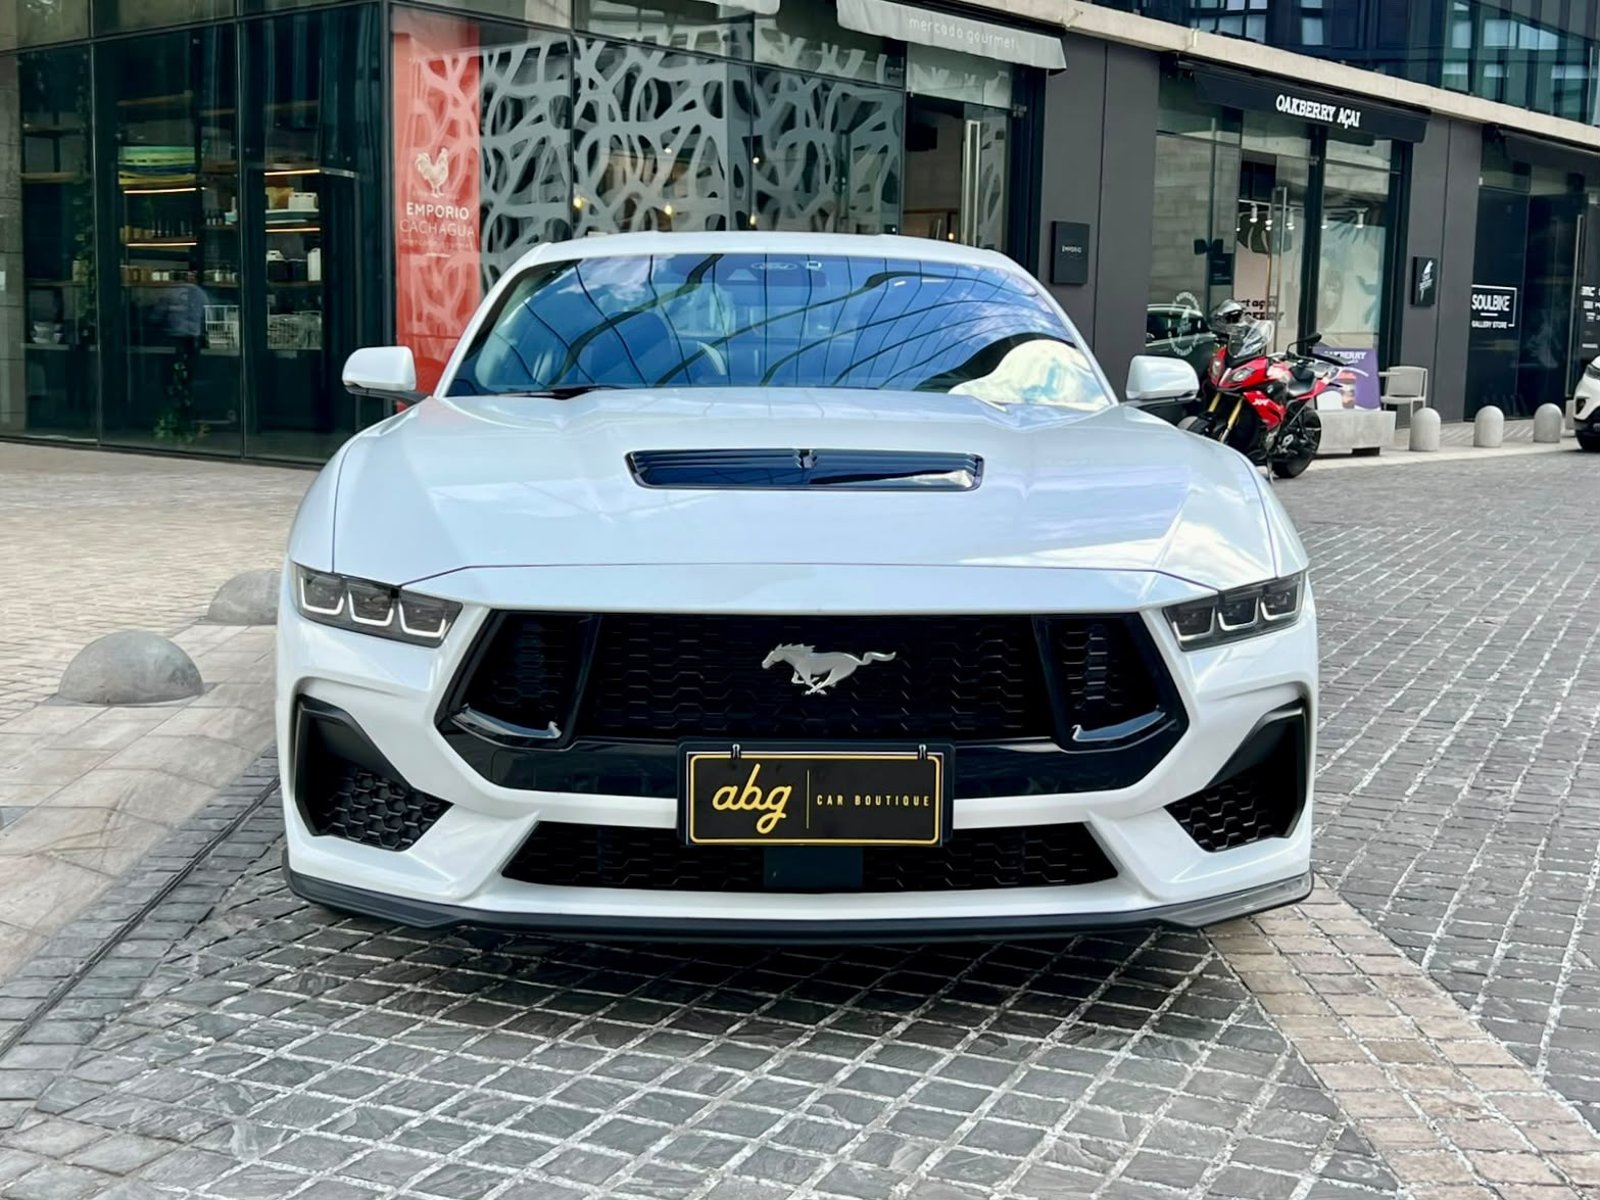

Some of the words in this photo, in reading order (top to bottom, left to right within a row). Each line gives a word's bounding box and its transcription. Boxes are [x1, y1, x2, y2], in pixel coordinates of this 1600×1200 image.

[909, 18, 963, 39] mercado
[966, 29, 1015, 49] gourmet
[1276, 94, 1336, 122] OAKBERRY
[1337, 107, 1361, 129] AÇAI
[406, 201, 470, 220] EMPORIO
[400, 219, 475, 238] CACHAGUA
[1471, 294, 1511, 312] SOULBIKE
[712, 763, 792, 834] abg
[816, 794, 844, 806] CAR
[854, 794, 930, 807] BOUTIQUE
